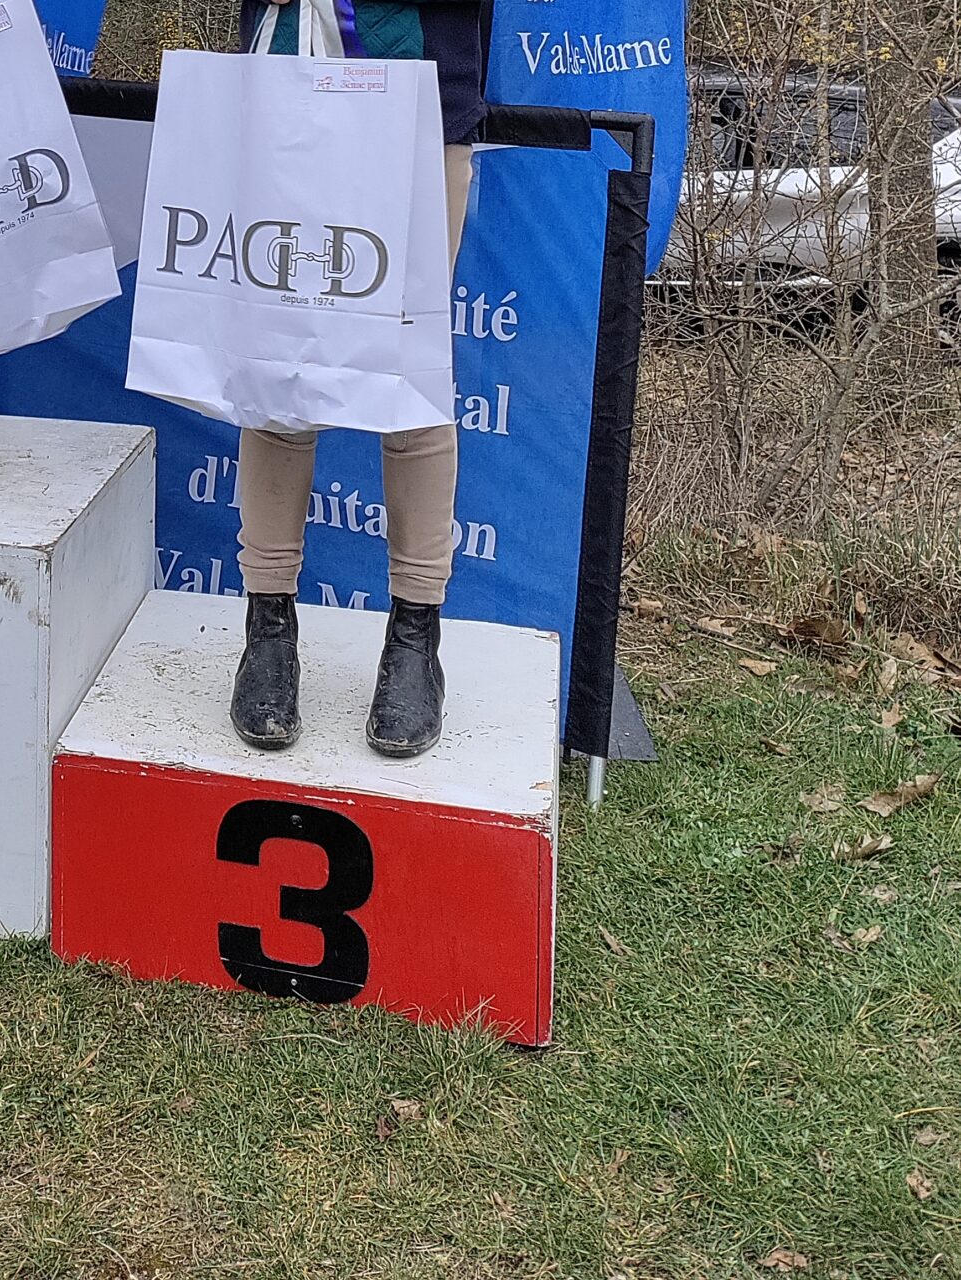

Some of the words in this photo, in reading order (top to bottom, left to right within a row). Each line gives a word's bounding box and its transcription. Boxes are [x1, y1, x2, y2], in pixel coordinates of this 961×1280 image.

[17, 211, 36, 225] 1974
[280, 293, 310, 307] depuis
[312, 296, 336, 307] 1974
[451, 286, 518, 342] ité
[216, 798, 375, 1005] 3
